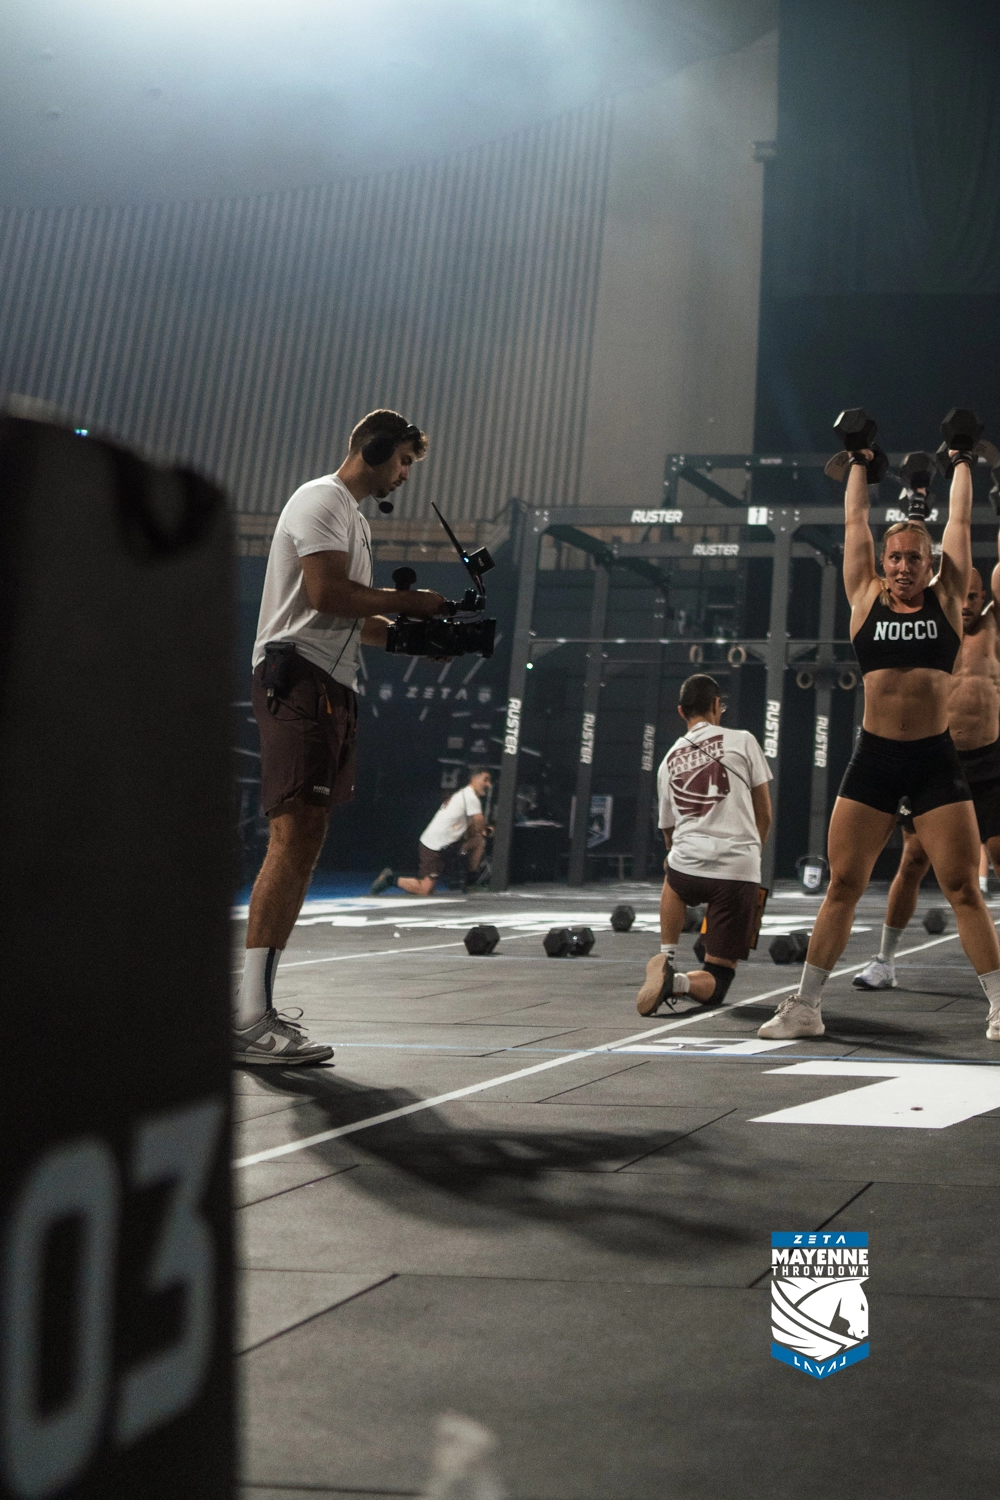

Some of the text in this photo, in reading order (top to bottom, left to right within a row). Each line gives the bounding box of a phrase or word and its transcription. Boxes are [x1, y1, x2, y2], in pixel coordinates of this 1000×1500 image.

[631, 509, 683, 524] RUSTER
[692, 544, 739, 556] RUSTER
[873, 620, 938, 641] NOCCO
[503, 697, 522, 756] RUSTER
[580, 712, 596, 764] RUSTER
[641, 723, 656, 771] RUSTER
[764, 700, 781, 758] RUSTER
[814, 715, 829, 768] RUSTER
[2, 1097, 228, 1499] 03
